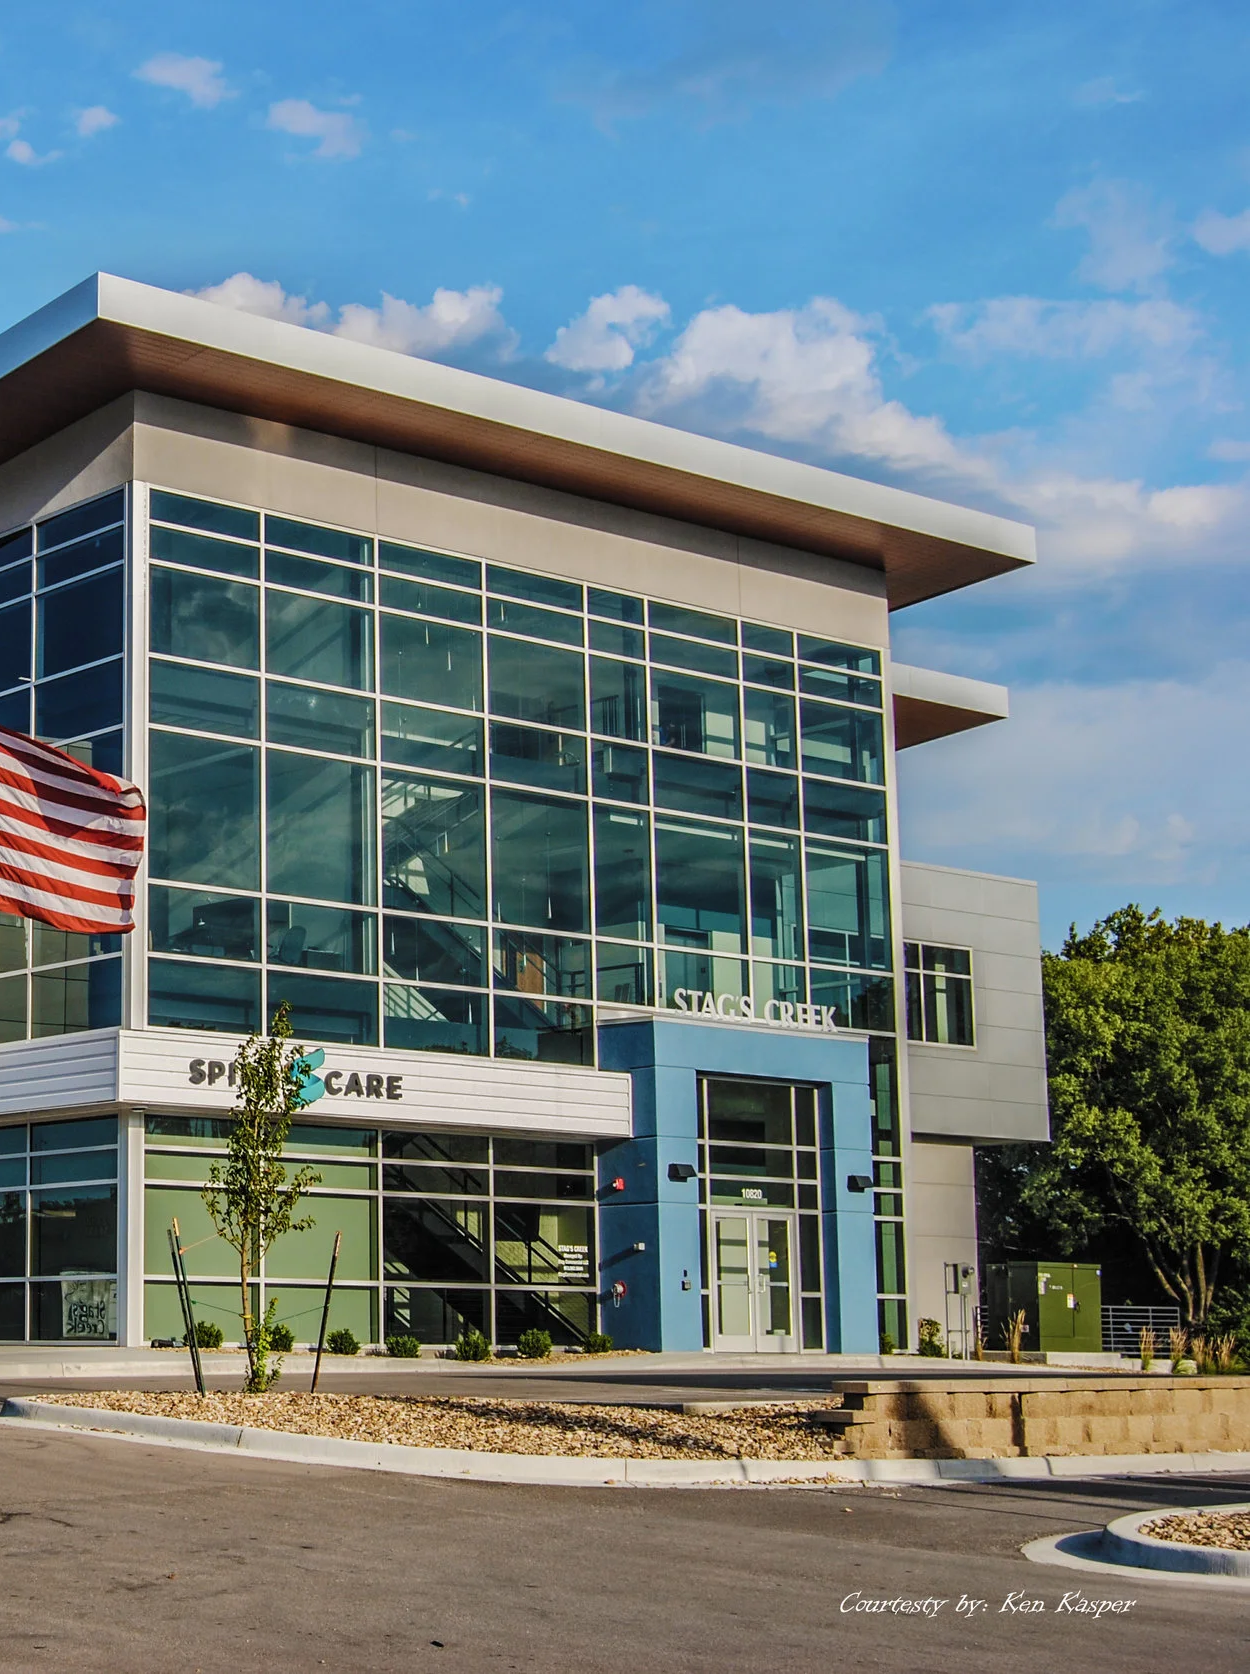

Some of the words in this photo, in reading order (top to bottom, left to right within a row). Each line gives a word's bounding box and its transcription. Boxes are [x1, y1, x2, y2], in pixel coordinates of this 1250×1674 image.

[674, 988, 751, 1023] STAG'S
[764, 1000, 838, 1032] CREEK
[325, 1071, 403, 1100] CARE
